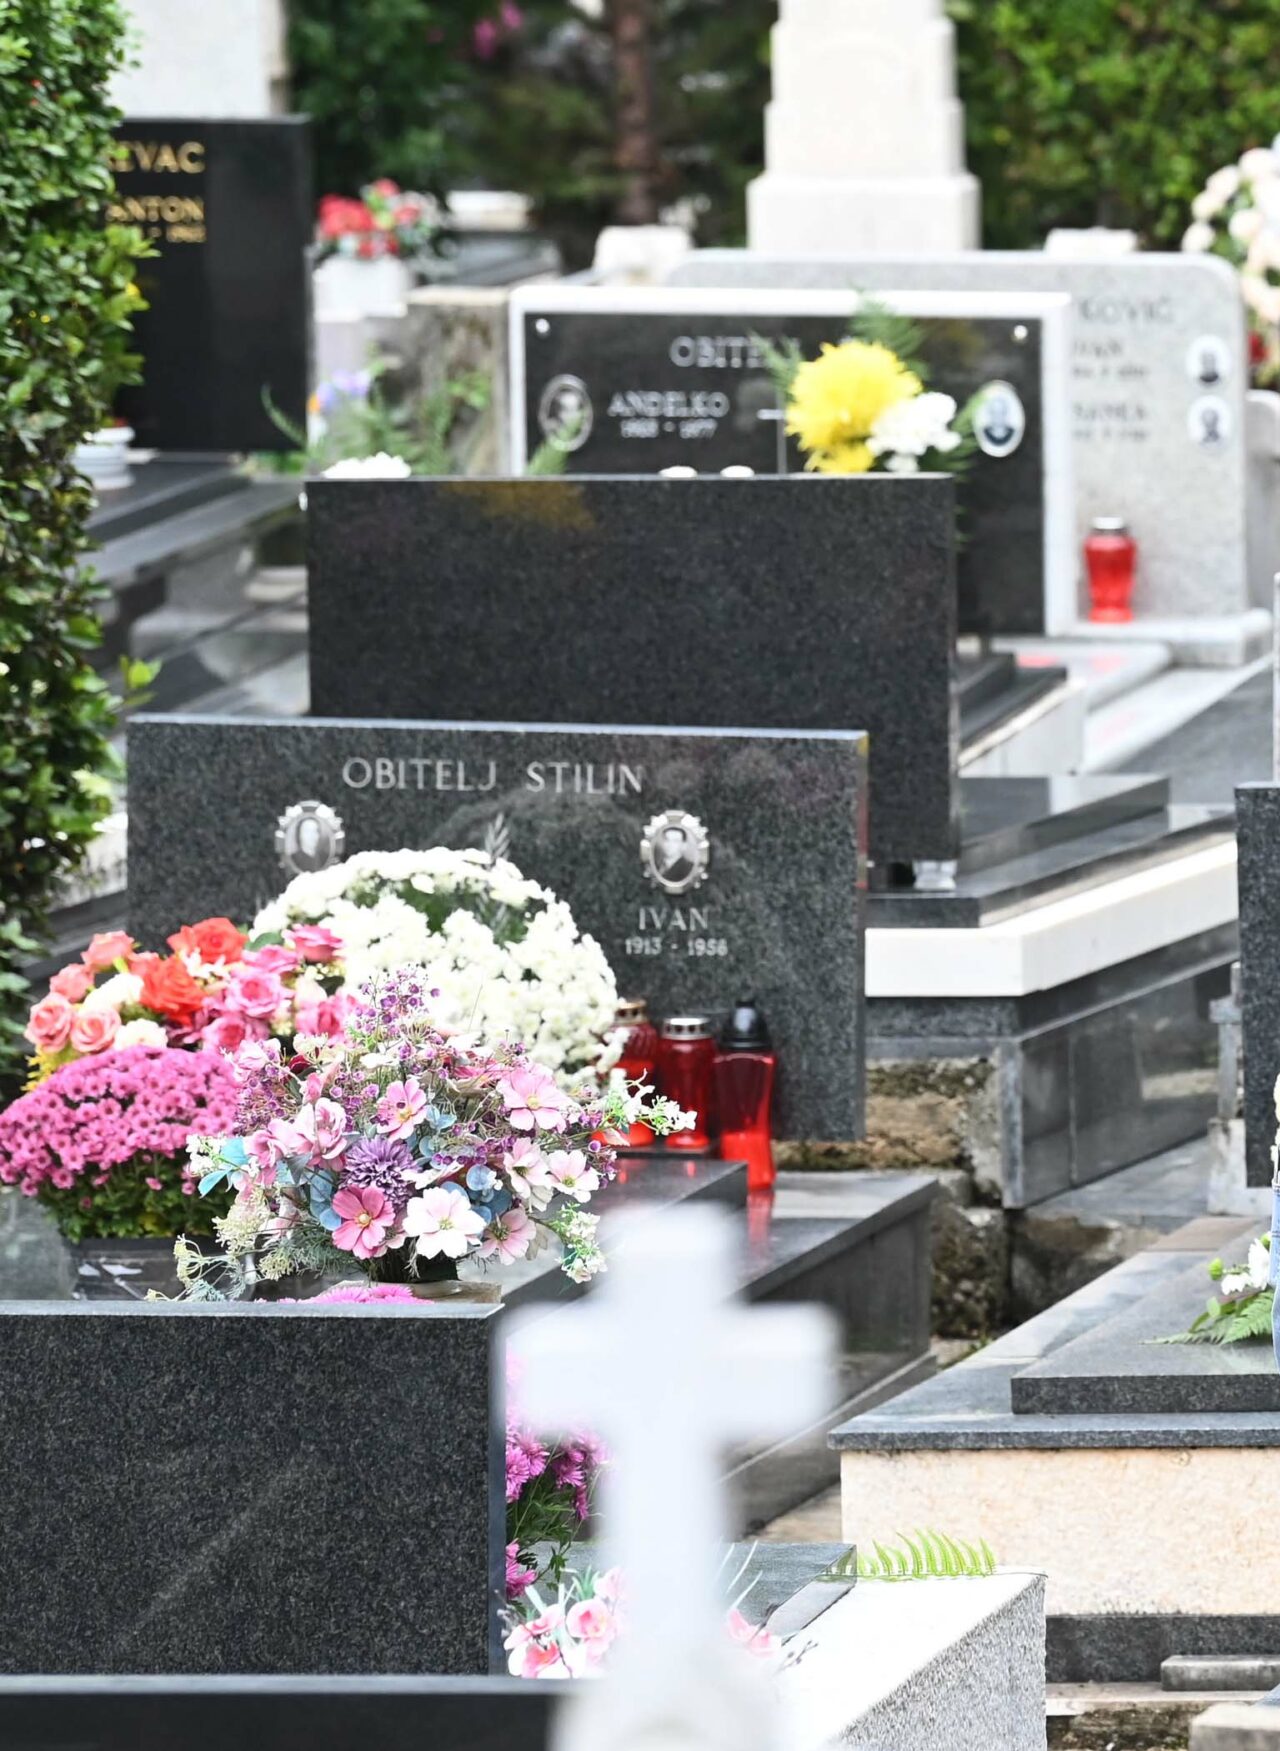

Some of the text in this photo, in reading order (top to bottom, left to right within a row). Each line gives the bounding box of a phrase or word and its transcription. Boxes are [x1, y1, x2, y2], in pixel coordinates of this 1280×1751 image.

[342, 757, 643, 794] OBITELJ STILIN
[639, 907, 710, 931] IVAN
